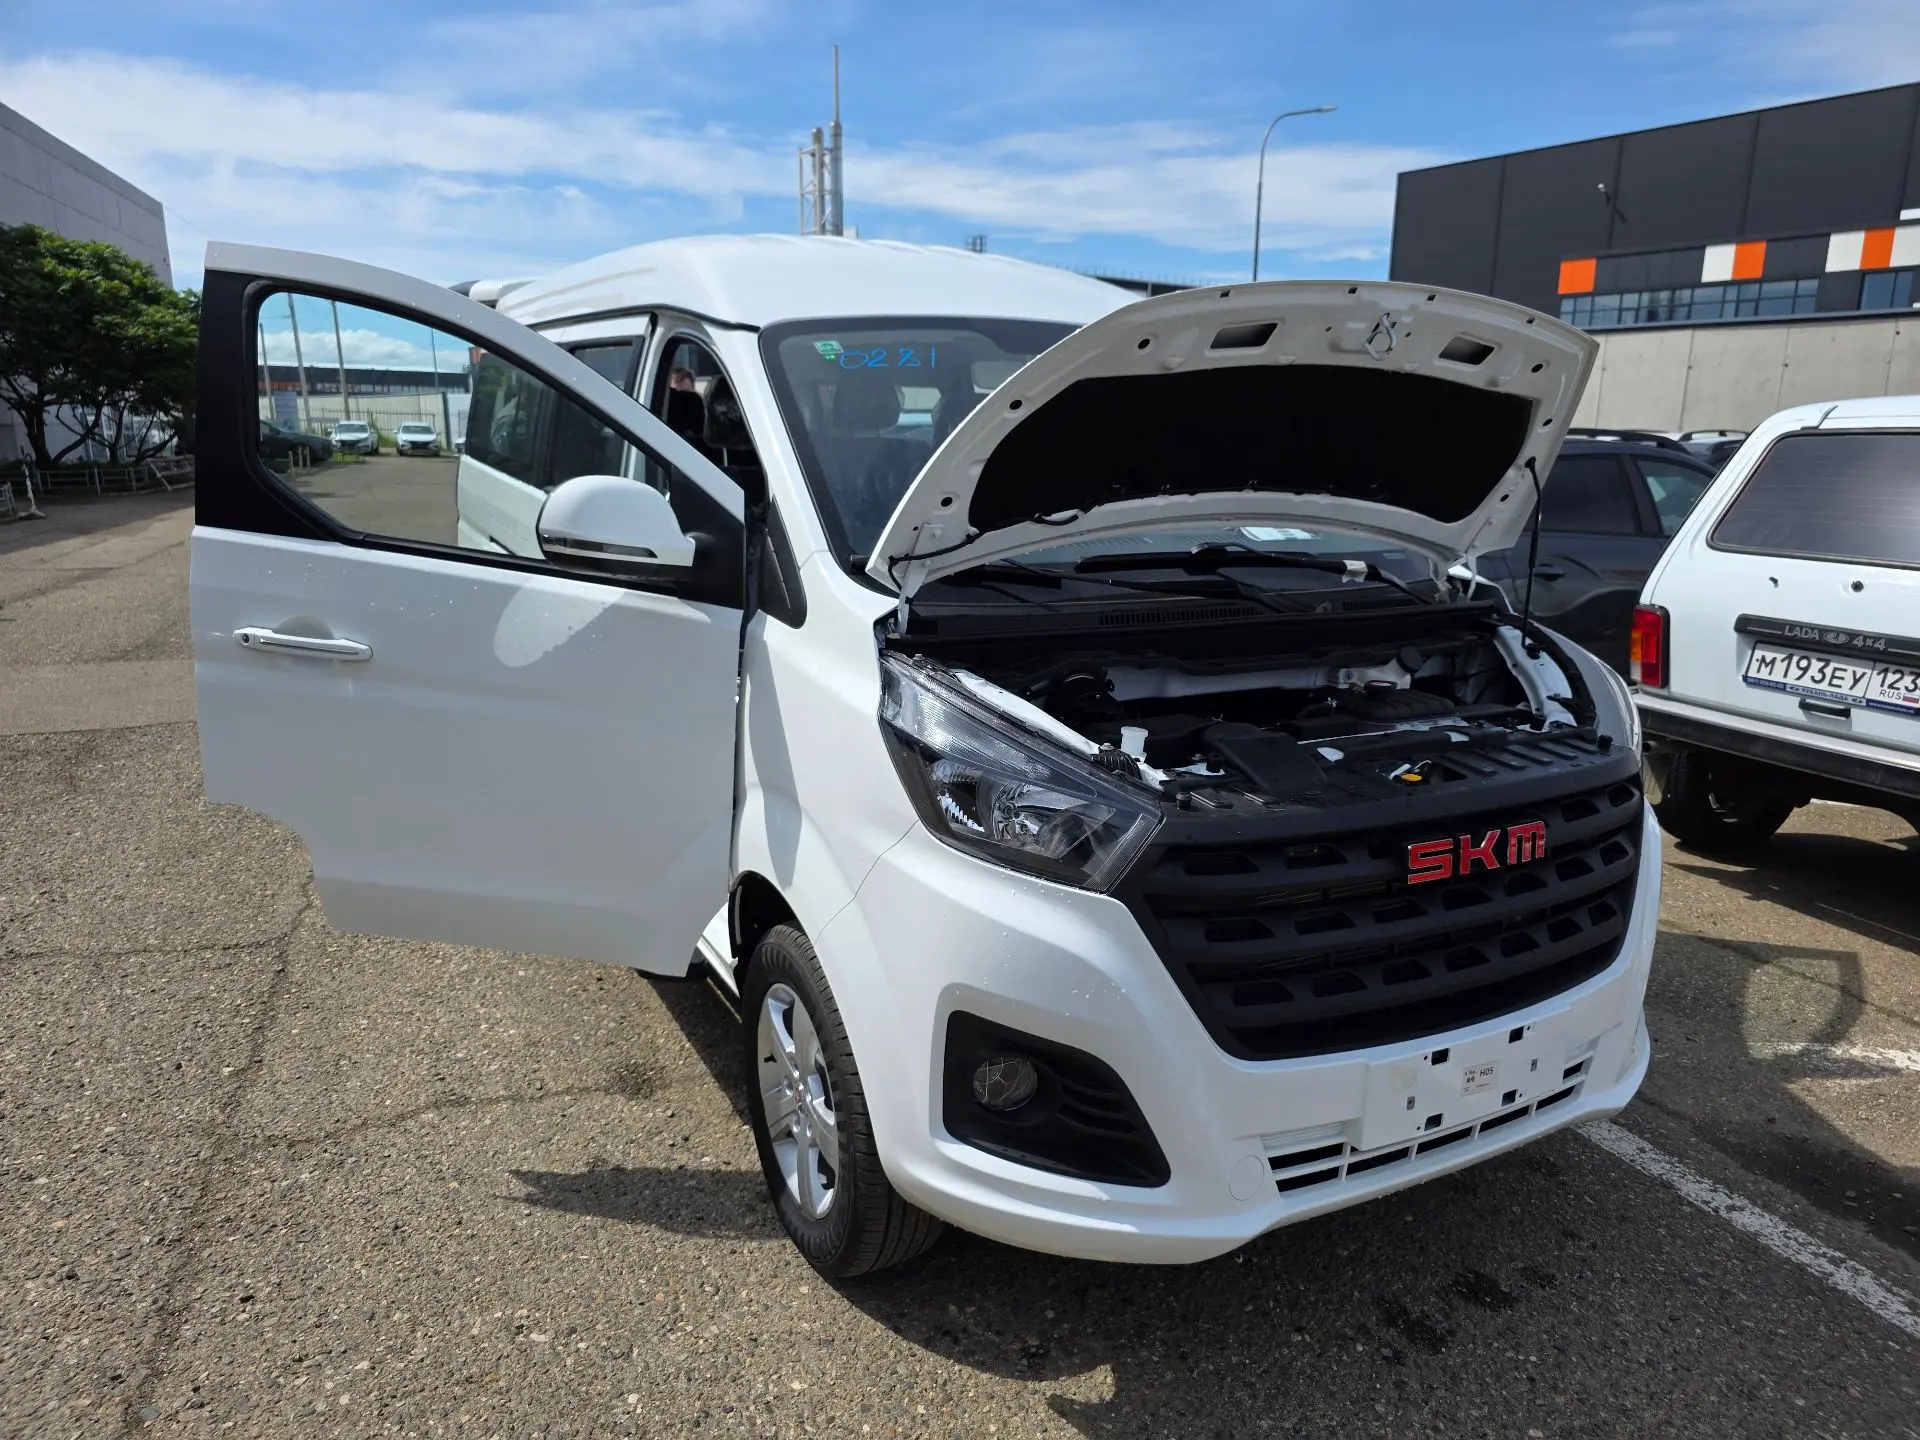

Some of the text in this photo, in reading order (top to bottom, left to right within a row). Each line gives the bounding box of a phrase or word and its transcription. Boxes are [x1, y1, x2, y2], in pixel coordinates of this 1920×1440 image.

[1784, 624, 1820, 641] LADA
[1876, 667, 1920, 693] 123
[1878, 689, 1902, 701] RUS
[1408, 820, 1546, 885] SKM
